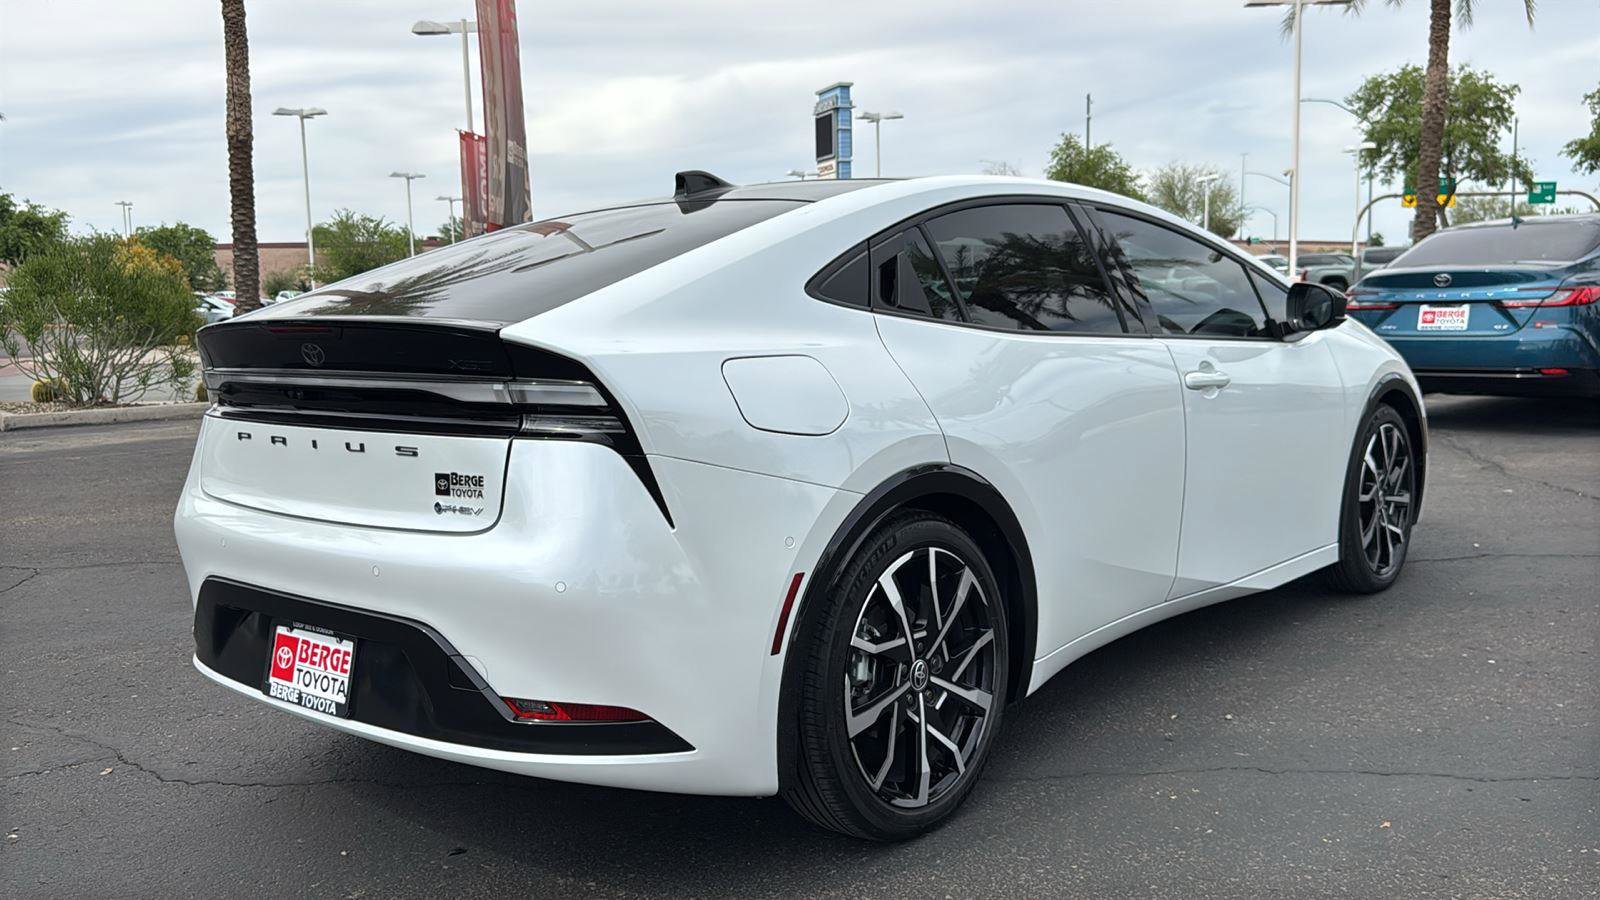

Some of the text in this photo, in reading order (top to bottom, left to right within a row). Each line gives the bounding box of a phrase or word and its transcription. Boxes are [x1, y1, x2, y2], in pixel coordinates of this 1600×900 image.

[237, 432, 419, 457] PRIUS
[450, 472, 485, 487] BERGE
[451, 488, 485, 499] TOYOTA
[298, 639, 351, 674] BERGE
[296, 667, 347, 697] TOYOTA
[269, 683, 337, 715] BERGE TOYOTA
